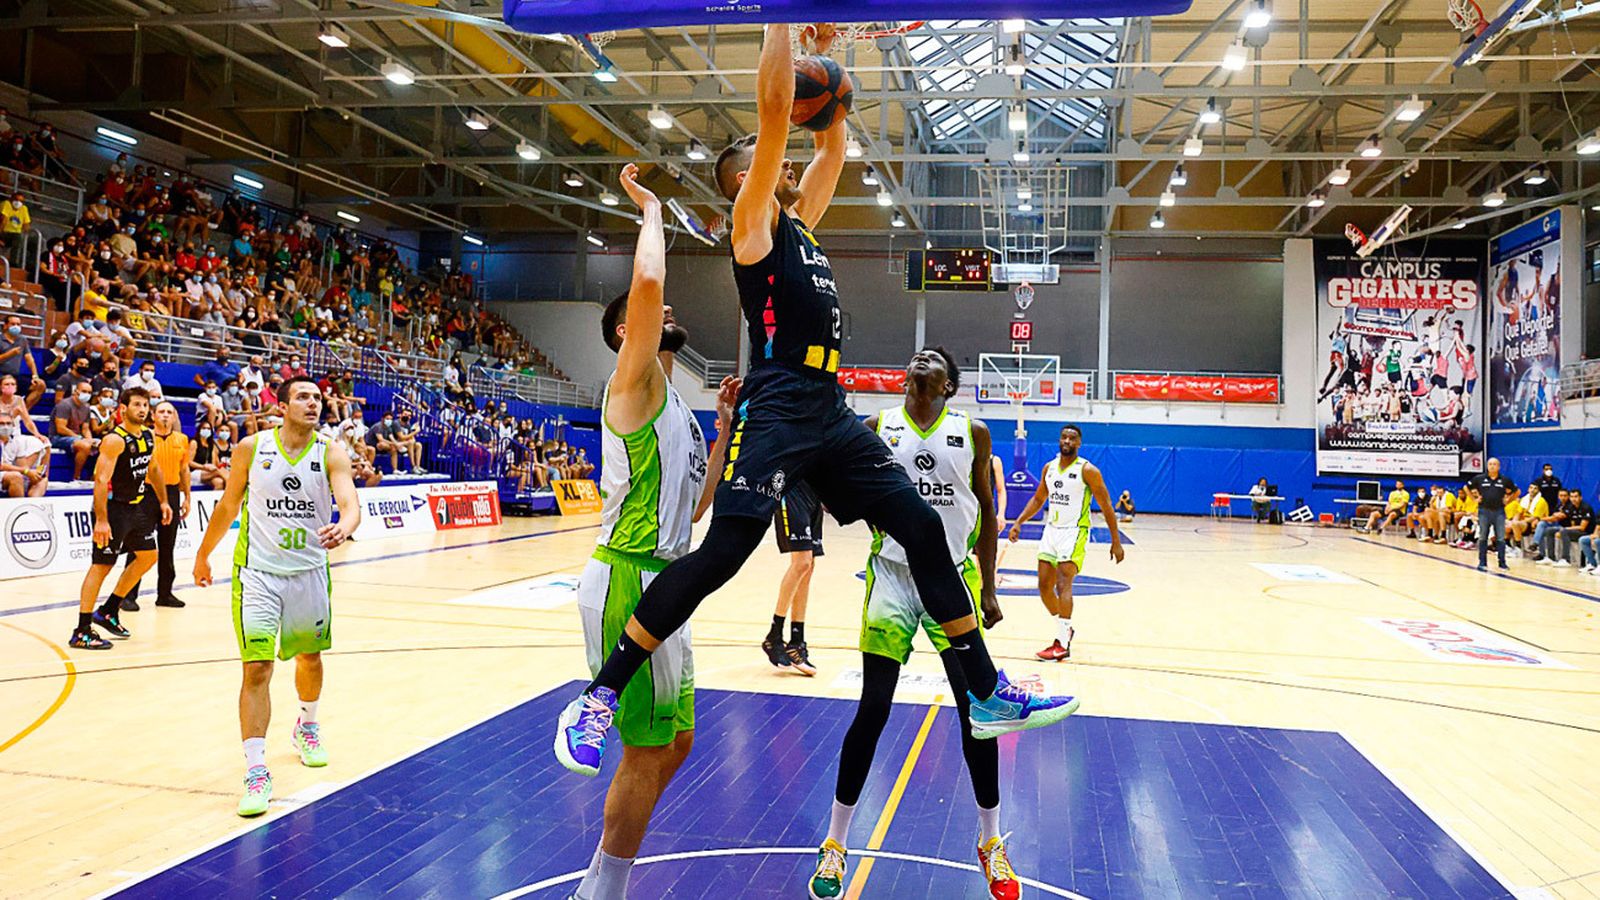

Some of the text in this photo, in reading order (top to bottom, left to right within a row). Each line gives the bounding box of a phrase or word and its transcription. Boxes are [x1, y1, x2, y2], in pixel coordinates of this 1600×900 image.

[799, 245, 831, 269] Len
[1360, 262, 1441, 279] CAMPUS
[1327, 278, 1477, 310] GIGANTES
[1360, 299, 1445, 309] DEL BASKET
[1012, 323, 1031, 339] 08
[266, 496, 315, 512] urbas
[368, 500, 411, 517] EL BERCIAL
[13, 532, 50, 542] VOLVO
[278, 527, 307, 550] 30
